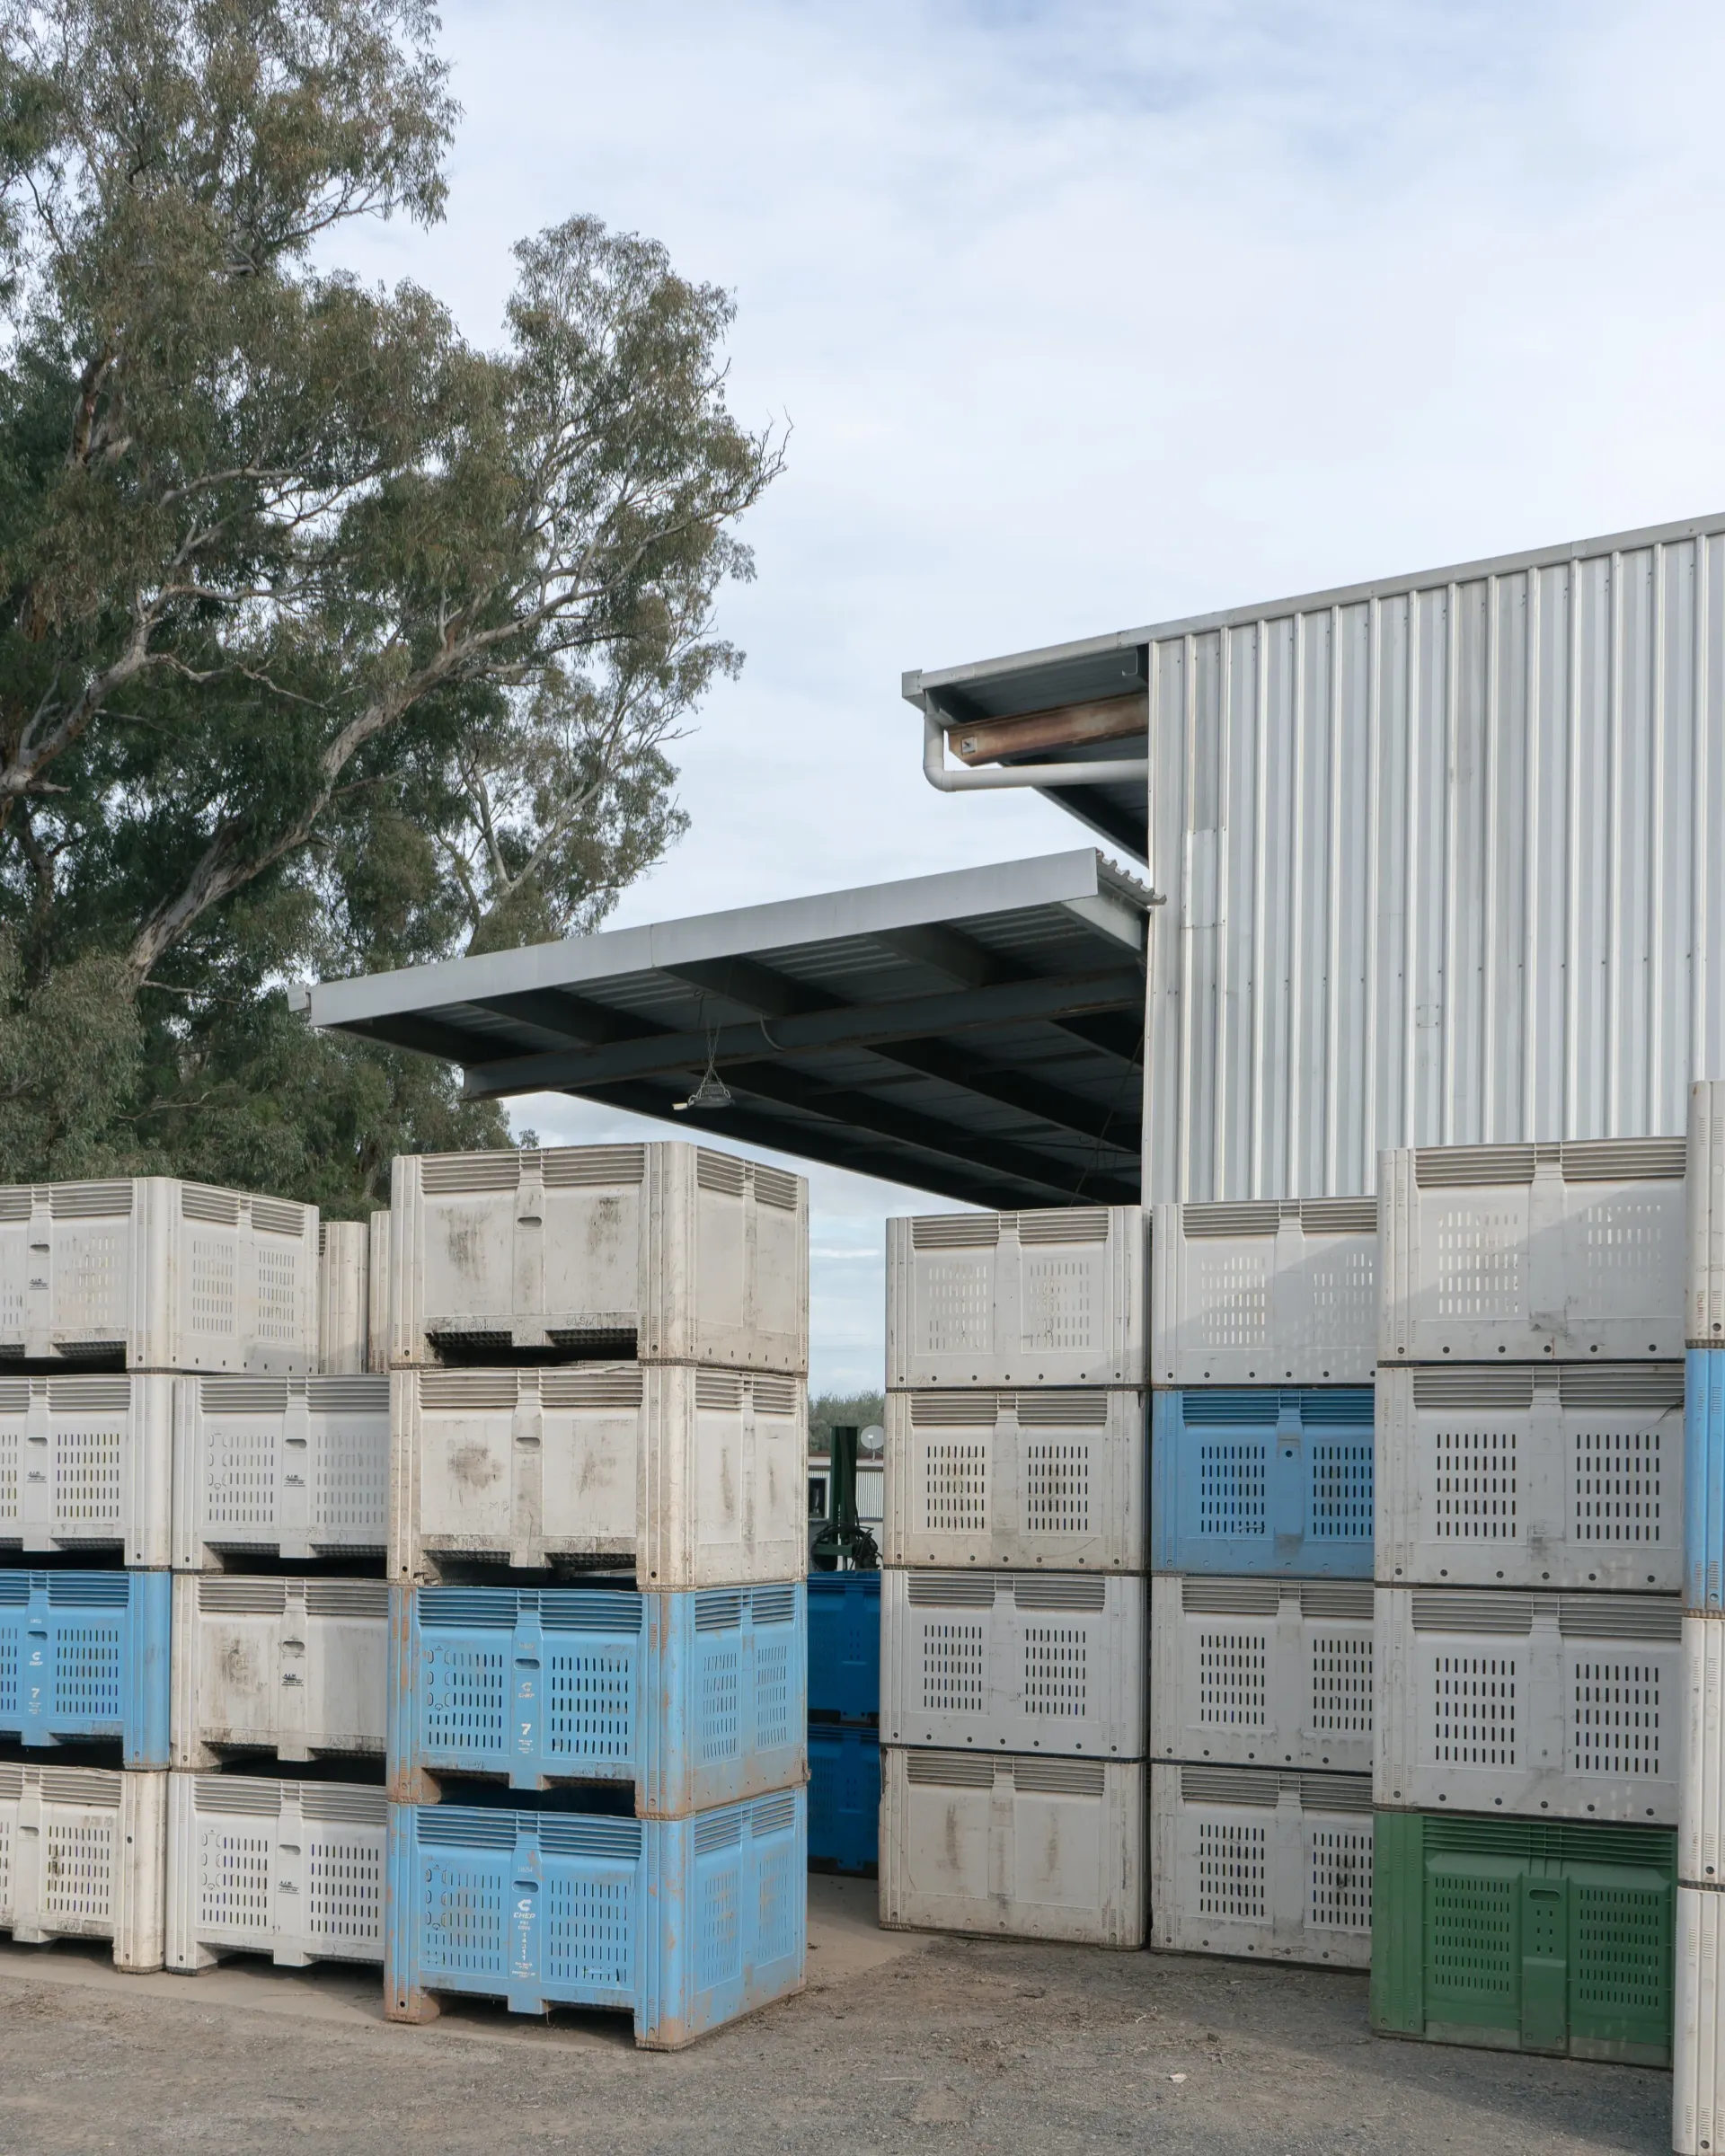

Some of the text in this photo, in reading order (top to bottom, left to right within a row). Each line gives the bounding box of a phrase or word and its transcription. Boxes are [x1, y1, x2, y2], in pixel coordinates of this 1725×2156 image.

[31, 1687, 40, 1699] 7
[521, 1723, 532, 1736] 7
[513, 1912, 536, 1920] CHEP
